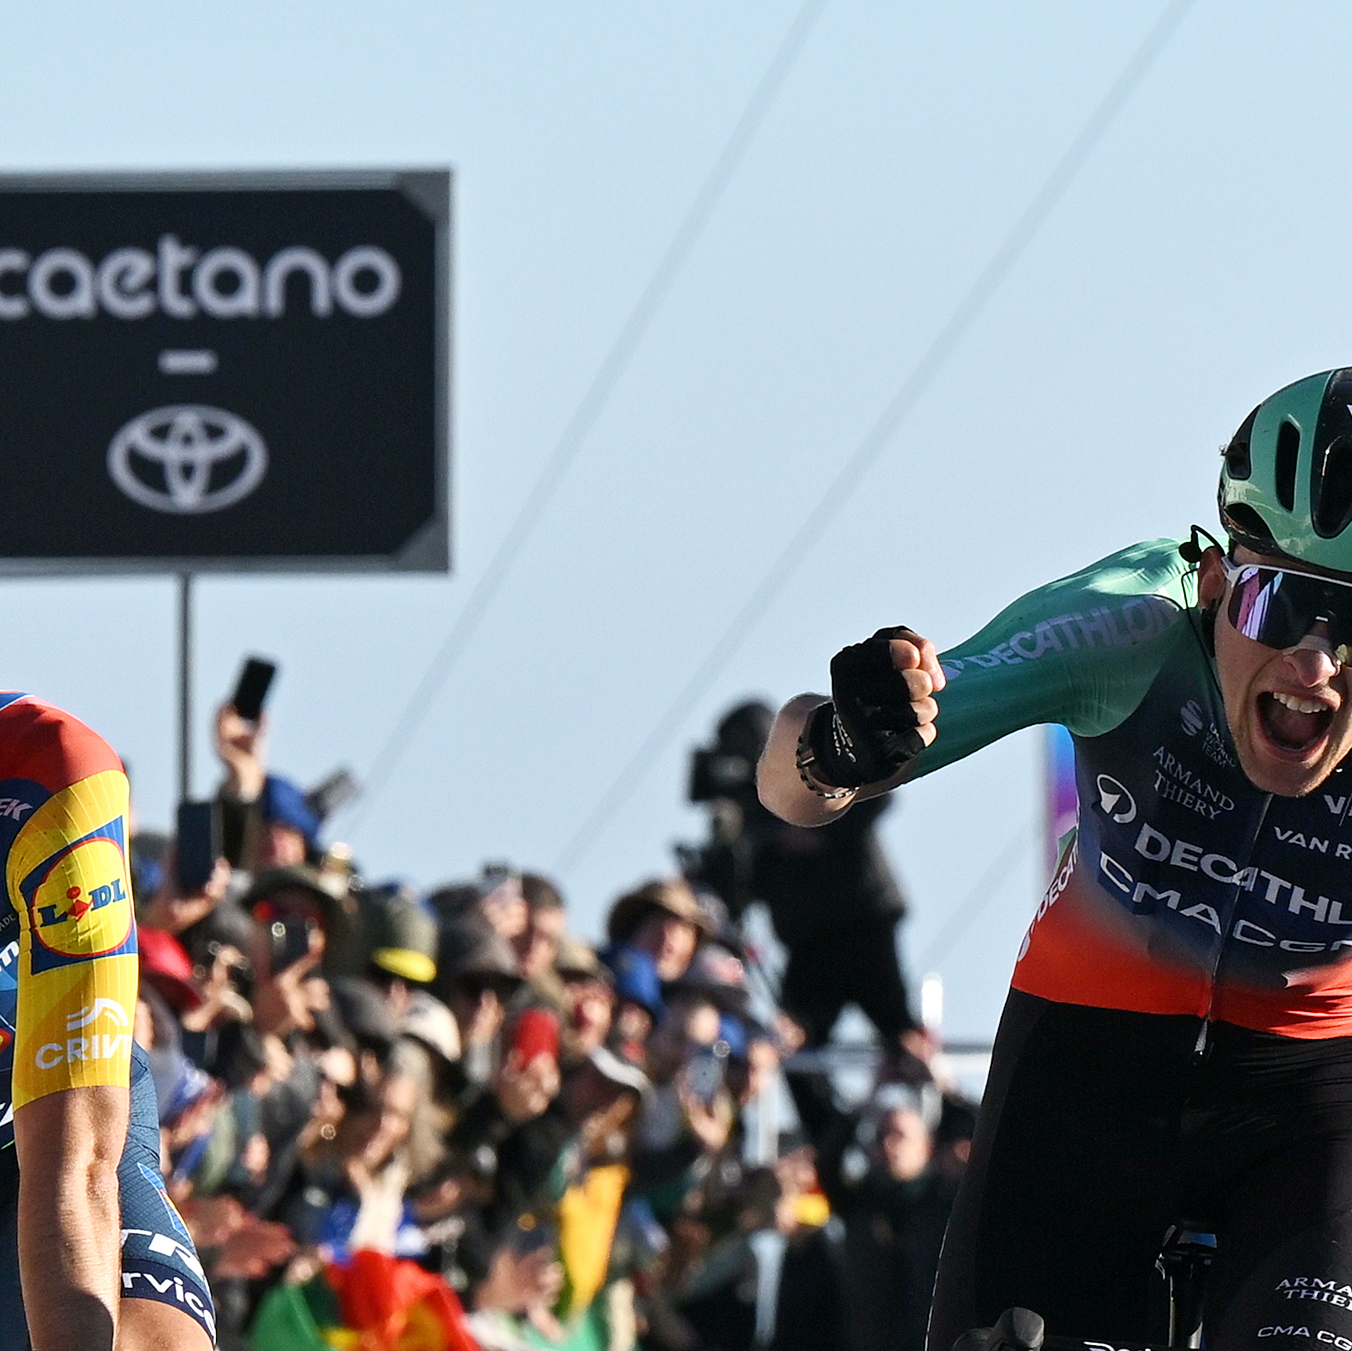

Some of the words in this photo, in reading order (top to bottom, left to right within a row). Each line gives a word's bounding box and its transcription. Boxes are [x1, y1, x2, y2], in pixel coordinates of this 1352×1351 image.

[1152, 746, 1235, 811] ARMAND
[1154, 770, 1222, 821] THIERY
[1274, 826, 1329, 853] VAN
[1100, 851, 1222, 936] CMA
[1257, 1326, 1311, 1338] CMA
